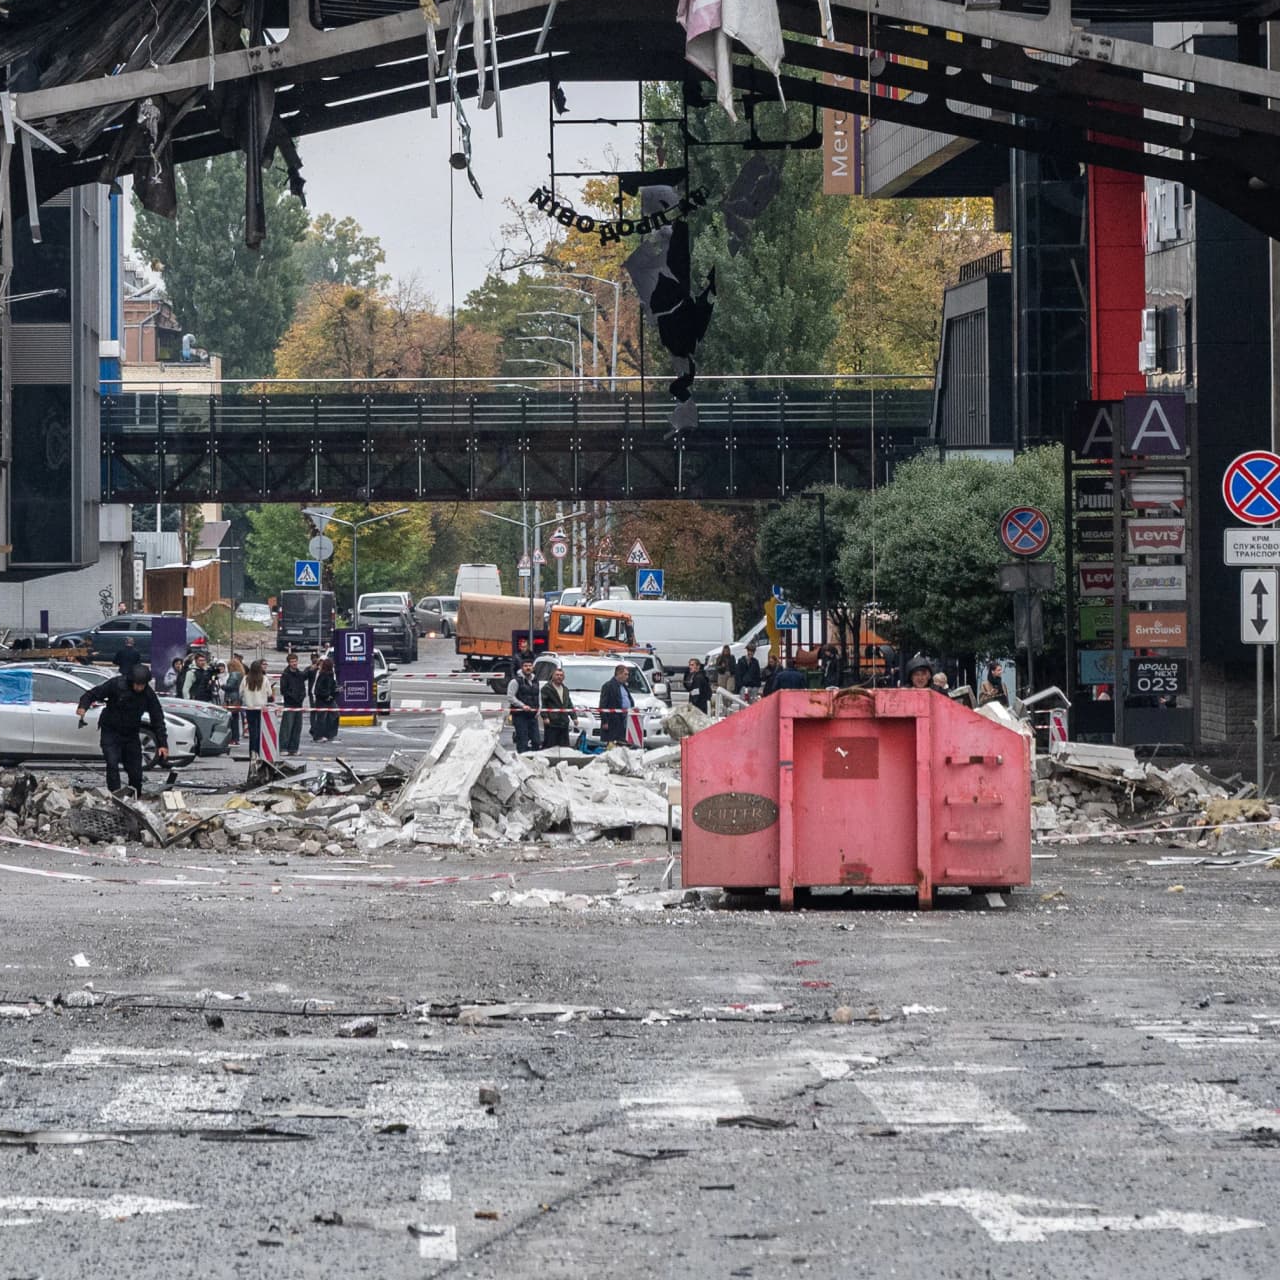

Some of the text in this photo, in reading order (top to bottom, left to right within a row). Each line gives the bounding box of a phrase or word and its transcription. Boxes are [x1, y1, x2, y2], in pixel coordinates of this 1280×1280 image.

[1131, 399, 1181, 451] A
[1079, 494, 1114, 508] PUM
[1086, 573, 1115, 583] LEV
[349, 636, 364, 652] P
[1137, 663, 1178, 671] APOLLO
